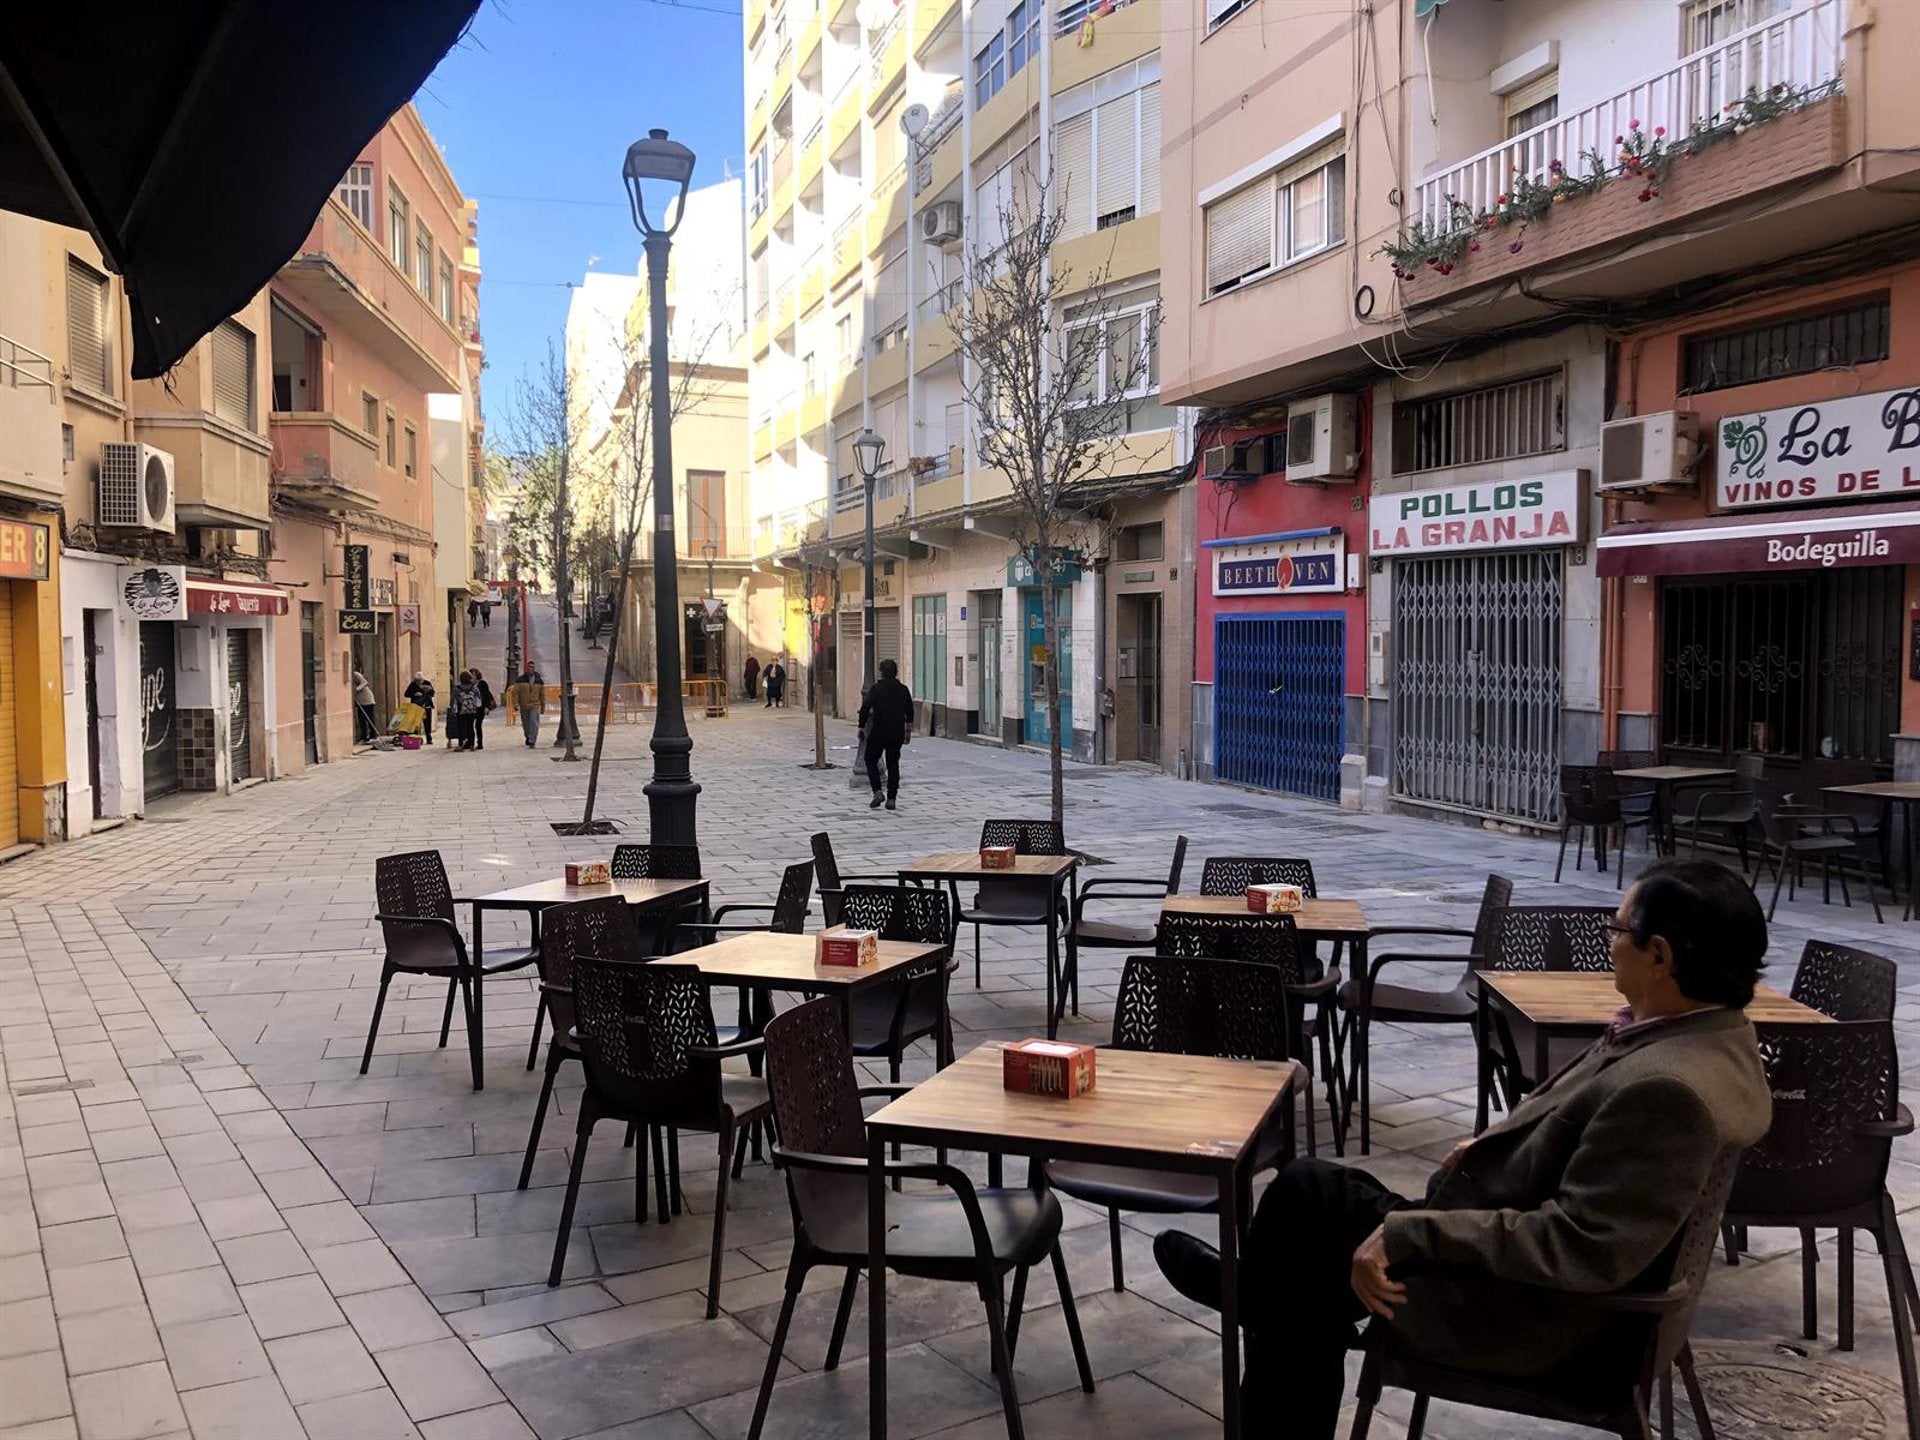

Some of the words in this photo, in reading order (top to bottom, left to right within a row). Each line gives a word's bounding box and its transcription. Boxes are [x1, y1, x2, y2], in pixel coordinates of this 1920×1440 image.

[1777, 407, 1852, 465] La
[1401, 481, 1543, 520] POLLOS
[1725, 477, 1816, 503] VINOS
[1838, 470, 1880, 493] DE
[35, 528, 45, 566] 8
[1373, 527, 1410, 550] LA
[1421, 511, 1571, 547] GRANJA
[1767, 530, 1889, 566] Bodeguilla
[342, 614, 372, 630] Eva
